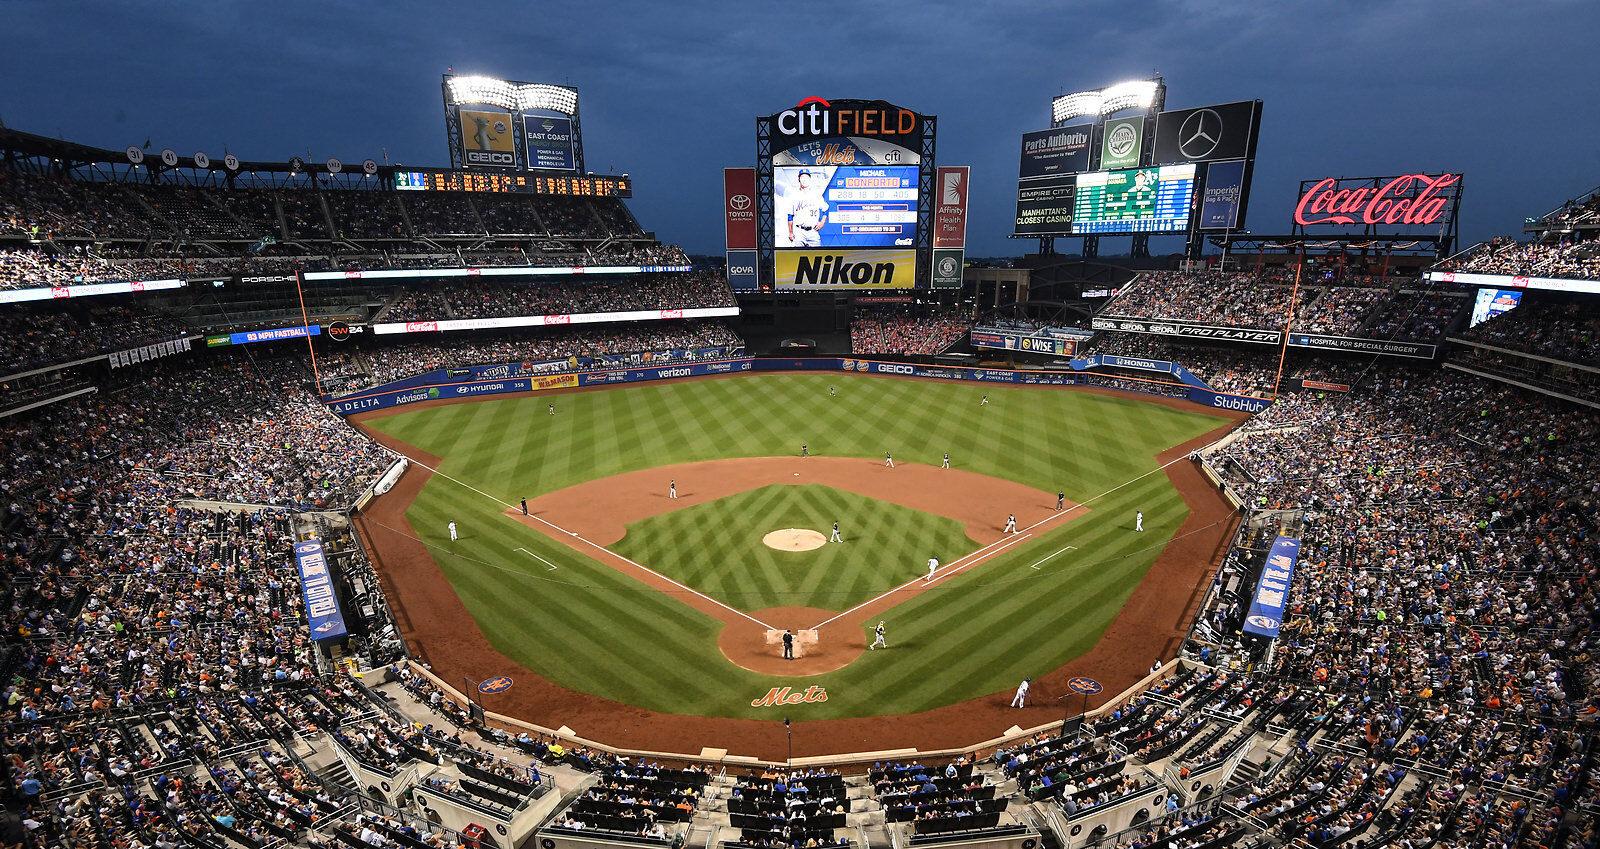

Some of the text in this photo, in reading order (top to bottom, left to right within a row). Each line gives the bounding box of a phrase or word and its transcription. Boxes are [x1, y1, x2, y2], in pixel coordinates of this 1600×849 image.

[838, 110, 916, 134] FIELD
[528, 132, 570, 142] EAST COAST
[1025, 132, 1088, 150] Parts Authority
[798, 141, 820, 152] LET'S
[811, 148, 822, 156] GO
[131, 150, 140, 160] 31
[165, 152, 174, 161] 41
[468, 152, 513, 164] GEICO
[817, 144, 856, 164] Mets
[198, 156, 206, 164] 14
[227, 158, 236, 167] 37
[848, 178, 899, 187] CONFORTO
[1295, 174, 1461, 226] Coca-Cola
[938, 206, 964, 216] Affinity
[1022, 207, 1067, 217] MANHATTAN'S
[940, 216, 962, 224] Health
[1016, 214, 1072, 225] CLOSEST CASINO
[943, 224, 957, 232] Plan
[730, 266, 754, 275] GOYA
[794, 254, 896, 285] Nikon
[247, 328, 306, 341] 93 MPH FASTBALL
[1178, 326, 1279, 345] PRO PLAYER
[207, 337, 230, 345] SUBWAY
[1032, 338, 1052, 352] WISE
[1310, 338, 1339, 347] HOSPITAL
[1353, 342, 1382, 350] SPECIAL
[1383, 344, 1418, 354] SURGERY
[878, 364, 914, 375] GEICO
[1124, 359, 1156, 369] HONDA
[658, 367, 691, 378] verizon
[550, 376, 574, 386] MASON
[470, 383, 504, 392] HYUNDAI
[396, 392, 428, 404] Advisors
[344, 398, 380, 411] DELTA
[1214, 396, 1264, 413] StubHub
[751, 686, 828, 707] Mets
